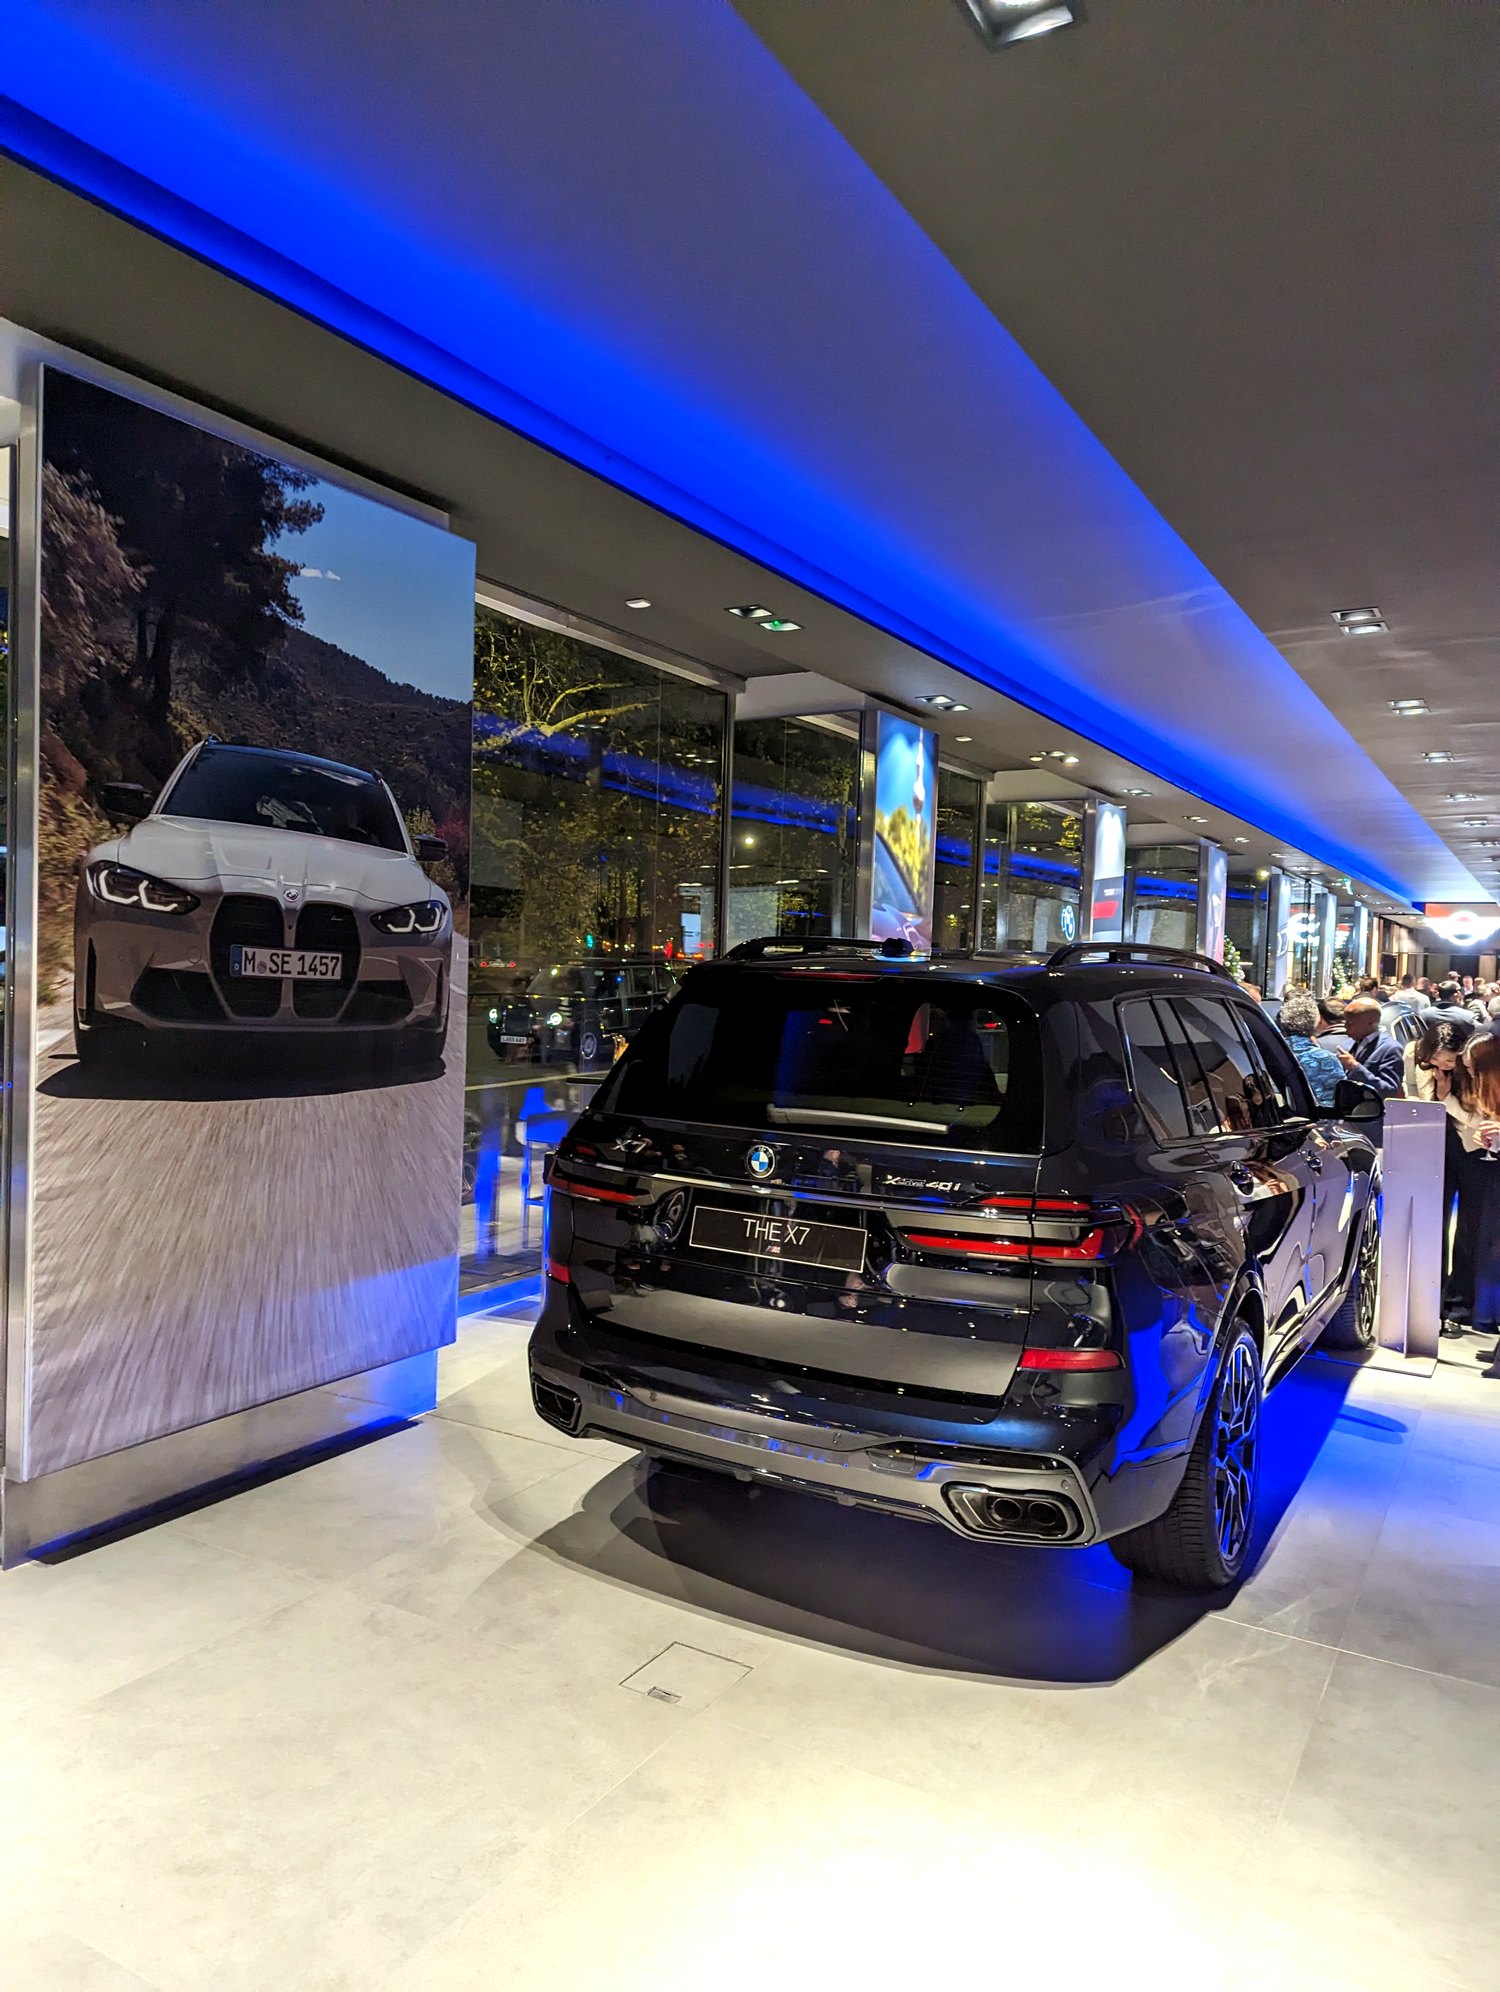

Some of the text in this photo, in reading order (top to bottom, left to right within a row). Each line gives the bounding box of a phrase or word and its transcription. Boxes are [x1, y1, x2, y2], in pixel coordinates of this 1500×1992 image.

[243, 951, 256, 973] M
[268, 952, 292, 975] SE
[297, 954, 340, 976] 1457
[611, 1138, 647, 1154] X7
[743, 1218, 811, 1246] THE X7
